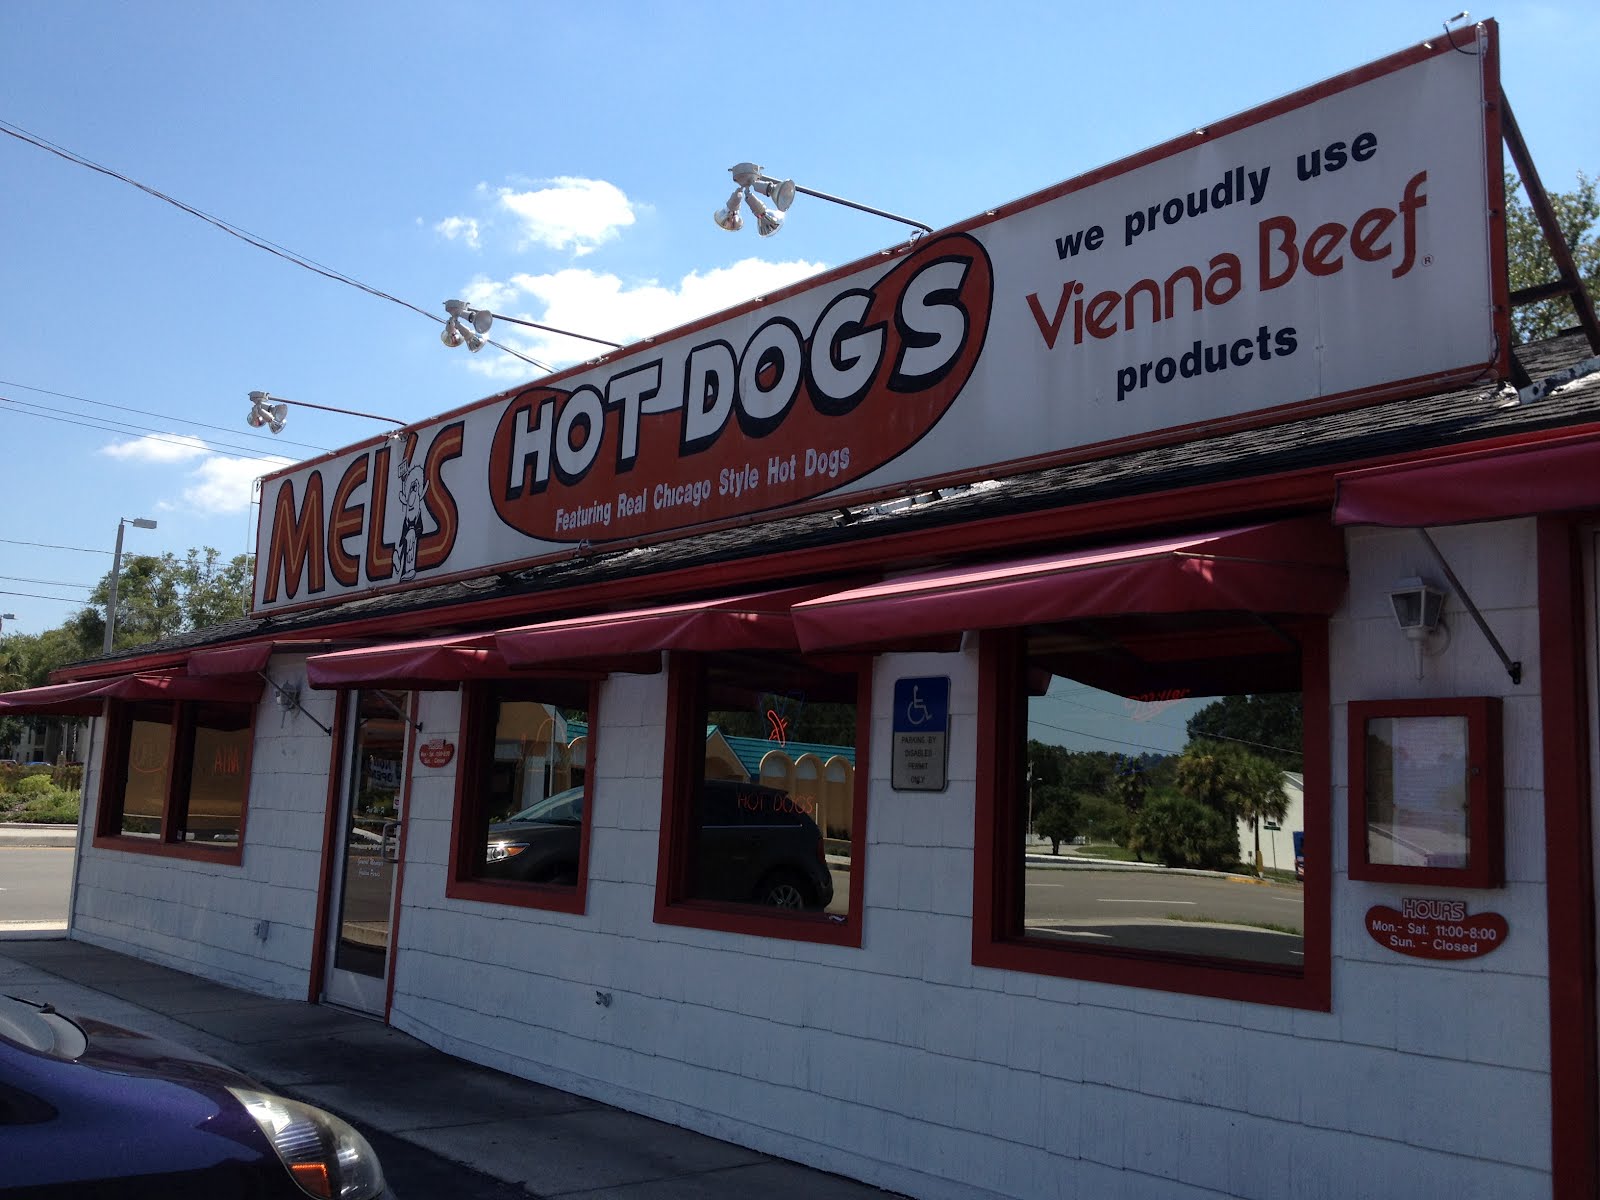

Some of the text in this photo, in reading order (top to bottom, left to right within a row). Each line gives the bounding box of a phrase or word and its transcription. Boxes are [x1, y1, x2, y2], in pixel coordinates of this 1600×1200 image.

[1055, 131, 1378, 260] we proudly use
[1025, 251, 1242, 349] Vienna
[1259, 170, 1428, 292] Beef
[505, 254, 975, 501] HOT DOGS
[1116, 324, 1299, 402] products
[555, 446, 851, 532] Featuring Real Chicago Style Hot Dogs
[928, 735, 937, 744] BY
[737, 793, 817, 814] HOT DOGS
[1402, 898, 1465, 921] HOURS
[1407, 922, 1430, 936] Sat.
[1435, 925, 1497, 941] 11:00-8:00
[1389, 934, 1416, 948] Sun.
[1432, 939, 1478, 953] Closed
